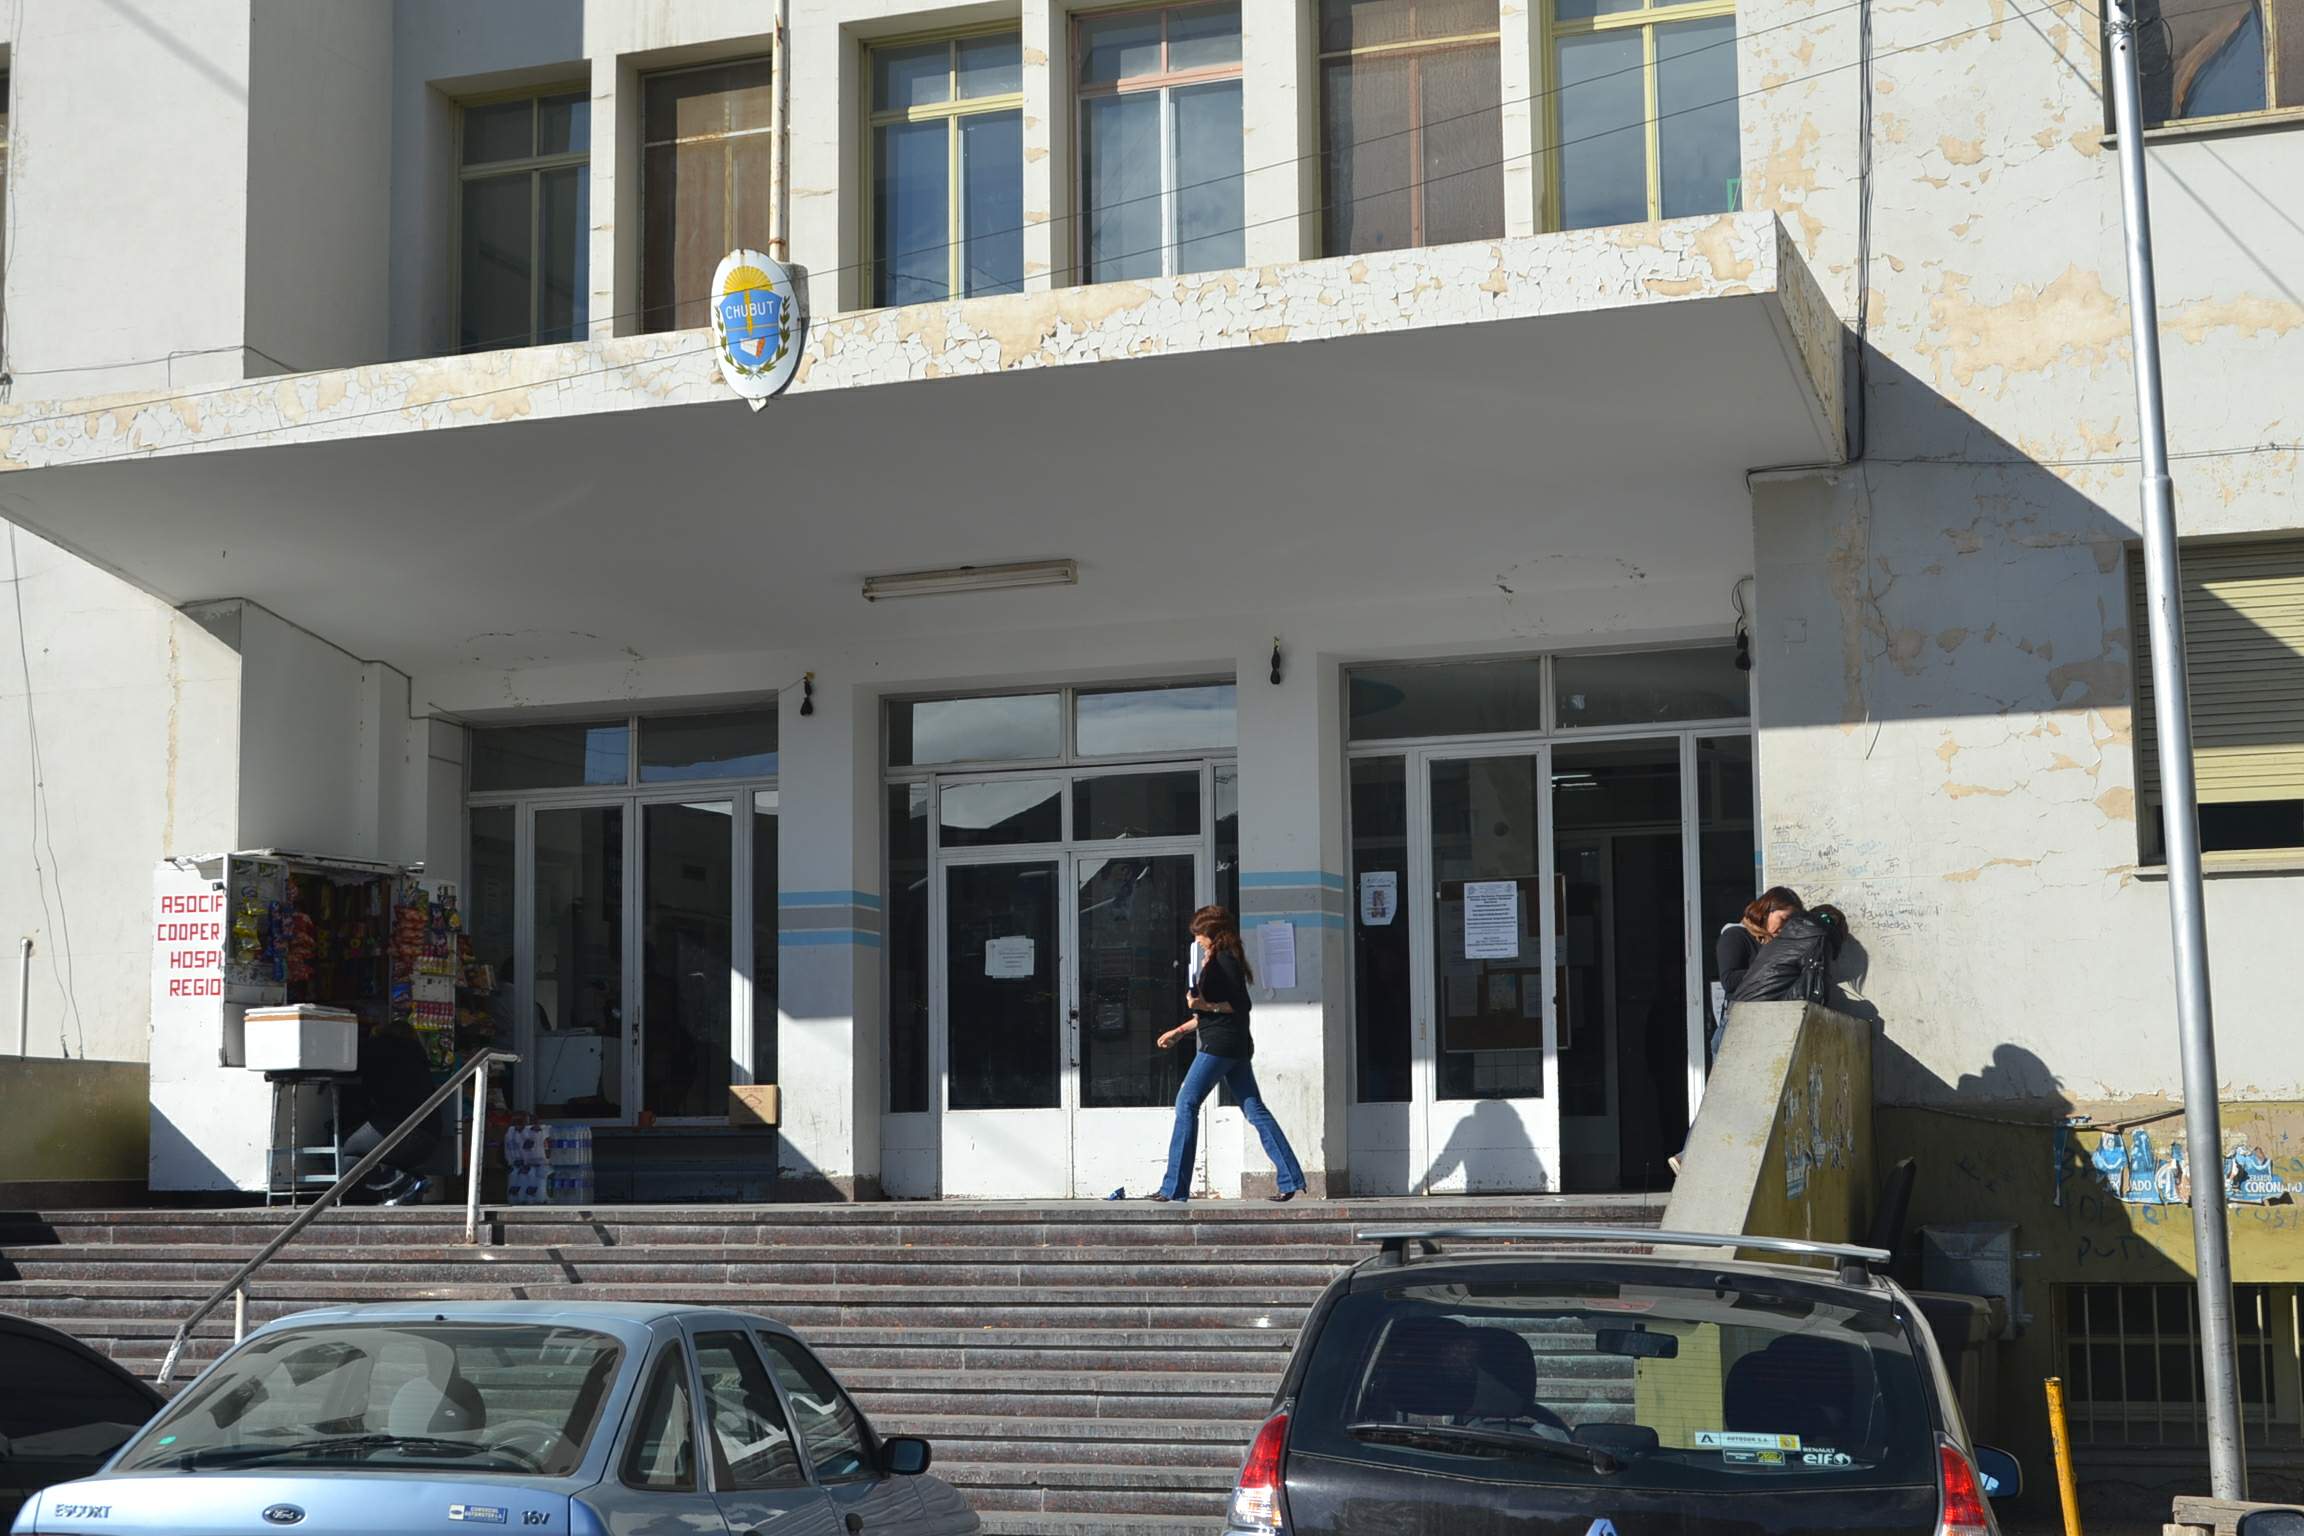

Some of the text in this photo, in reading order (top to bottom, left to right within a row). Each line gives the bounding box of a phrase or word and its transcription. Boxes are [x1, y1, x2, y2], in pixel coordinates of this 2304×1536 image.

[725, 300, 774, 320] CHUBUT
[157, 923, 220, 941] COOPER
[169, 978, 221, 996] REGIO
[1803, 1453, 1834, 1465] elf
